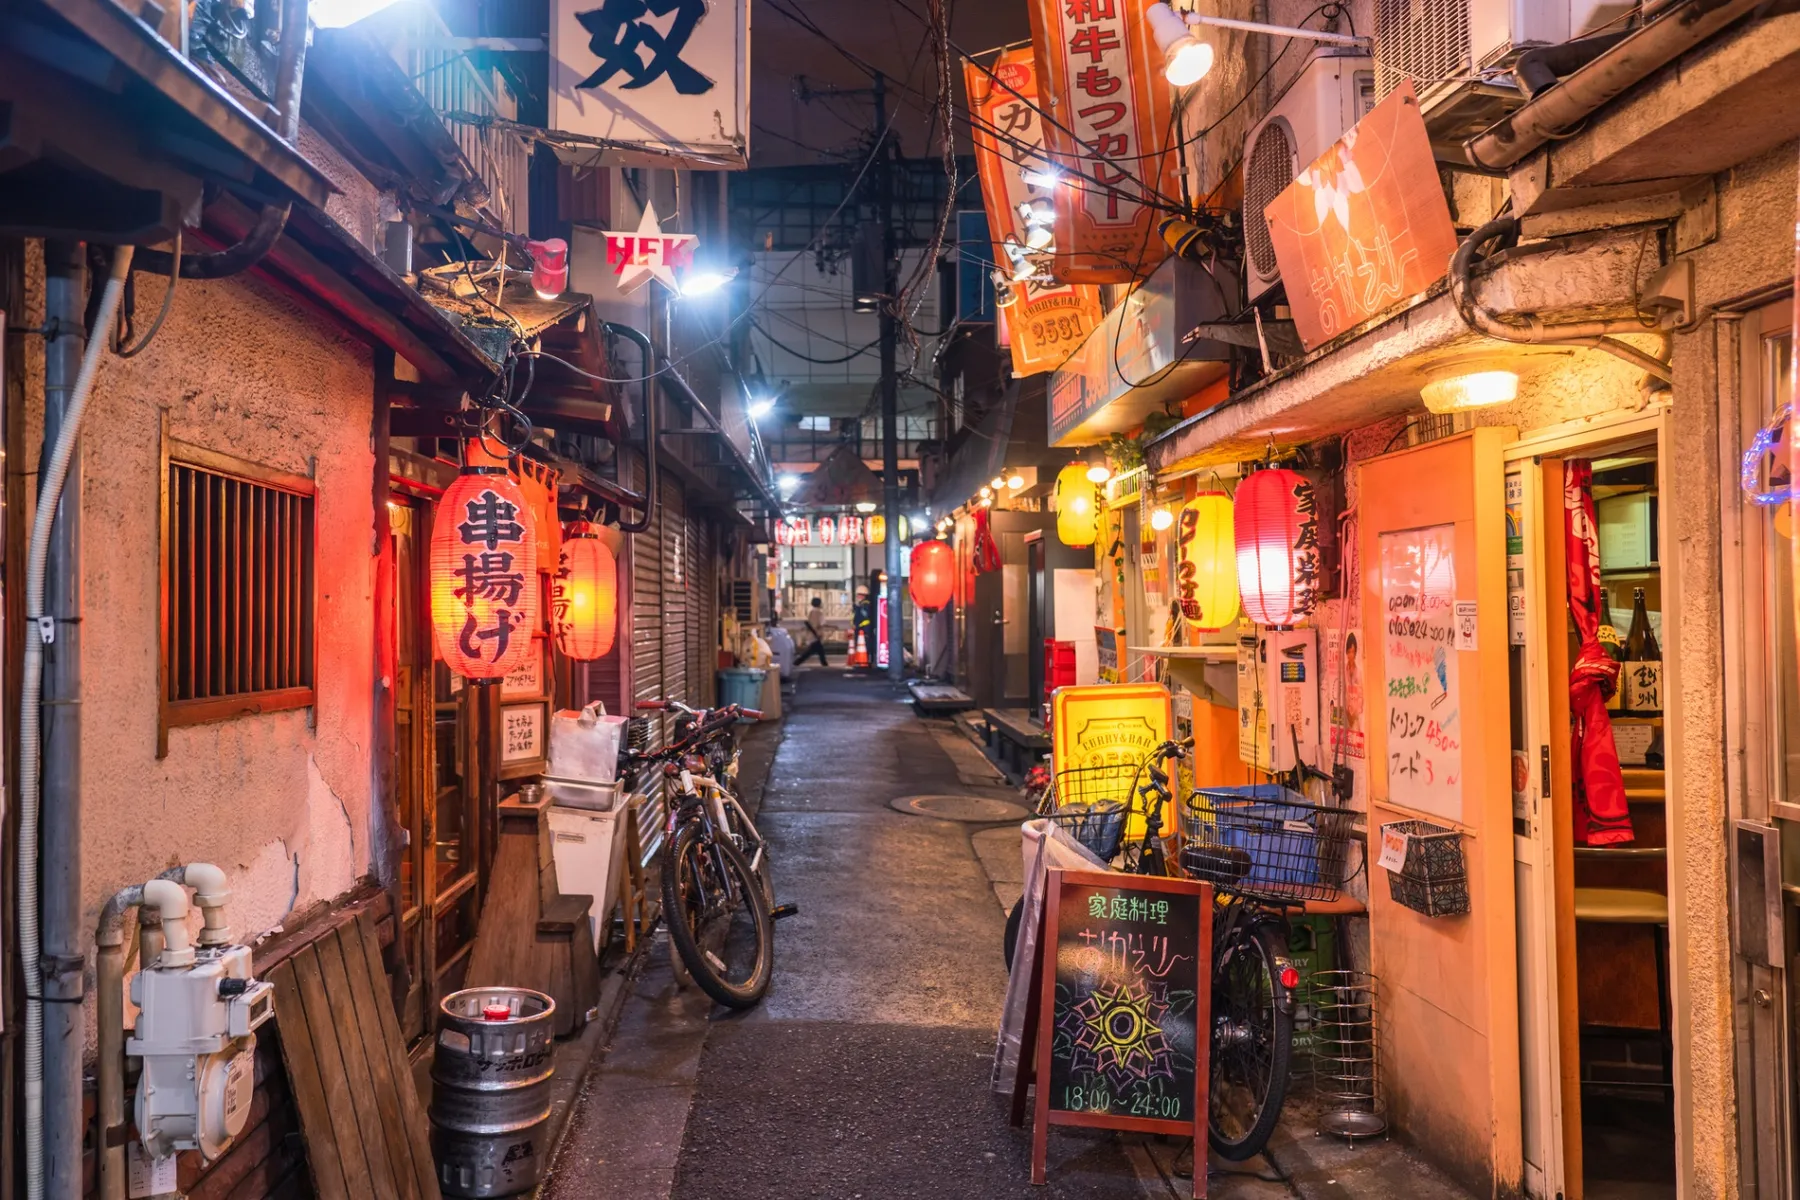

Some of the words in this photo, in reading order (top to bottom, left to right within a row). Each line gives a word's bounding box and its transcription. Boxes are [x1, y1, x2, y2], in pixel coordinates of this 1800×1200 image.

[574, 0, 717, 95] 奴
[1065, 0, 1132, 219] 和牛もつカレー
[453, 489, 526, 665] 串揚げ
[1389, 706, 1425, 739] ドリンク
[1082, 732, 1152, 751] CURRY&BAR
[1391, 749, 1422, 780] フード
[1088, 892, 1169, 925] 家庭料理
